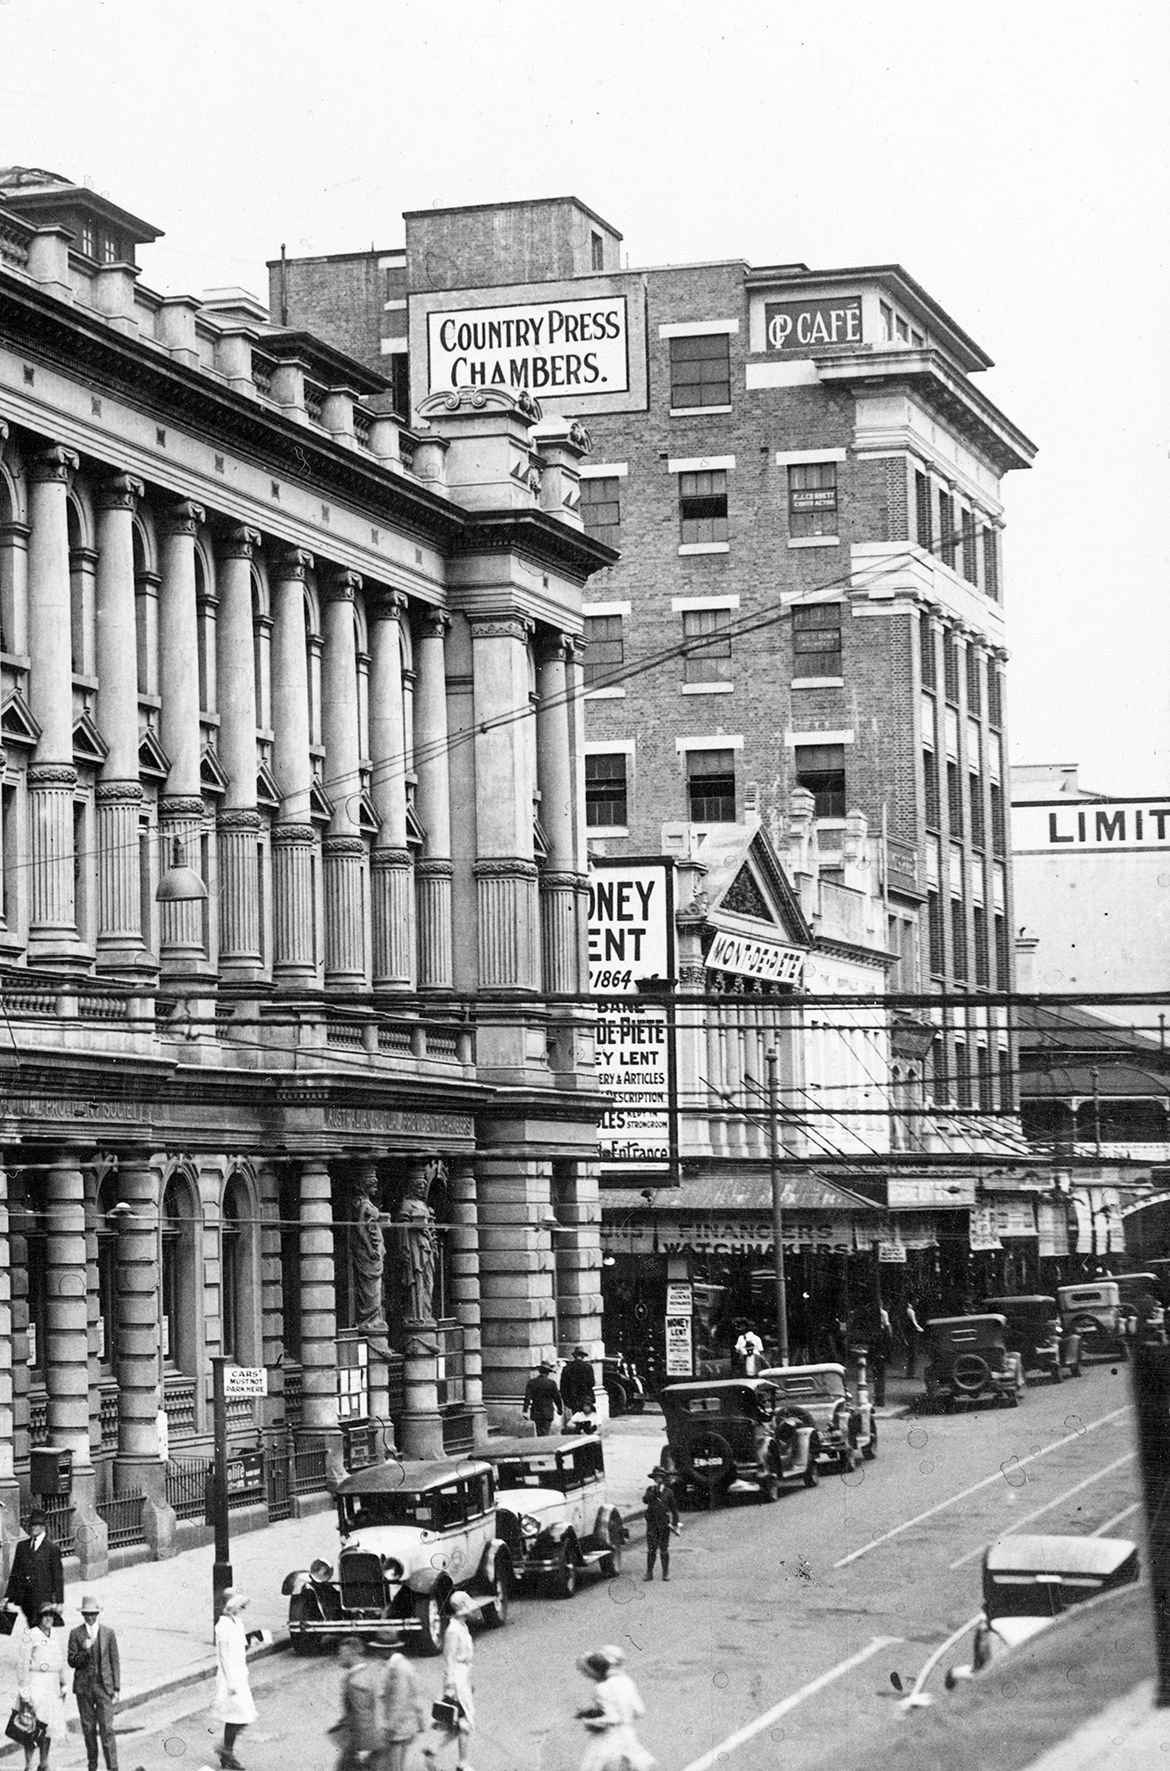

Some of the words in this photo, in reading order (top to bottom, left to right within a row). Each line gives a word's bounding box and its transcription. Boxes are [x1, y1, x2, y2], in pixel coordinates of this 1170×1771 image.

[439, 316, 544, 352] COUNTRY
[548, 309, 620, 344] PRESS
[797, 302, 860, 343] CAFÉ
[451, 352, 608, 388] CHAMBERS.
[1049, 810, 1170, 842] LIMIT
[593, 969, 632, 990] 1864
[620, 1051, 659, 1066] LENT
[616, 1074, 622, 1084] &
[624, 1071, 665, 1084] ARTICLES
[611, 1140, 667, 1159] Entrance
